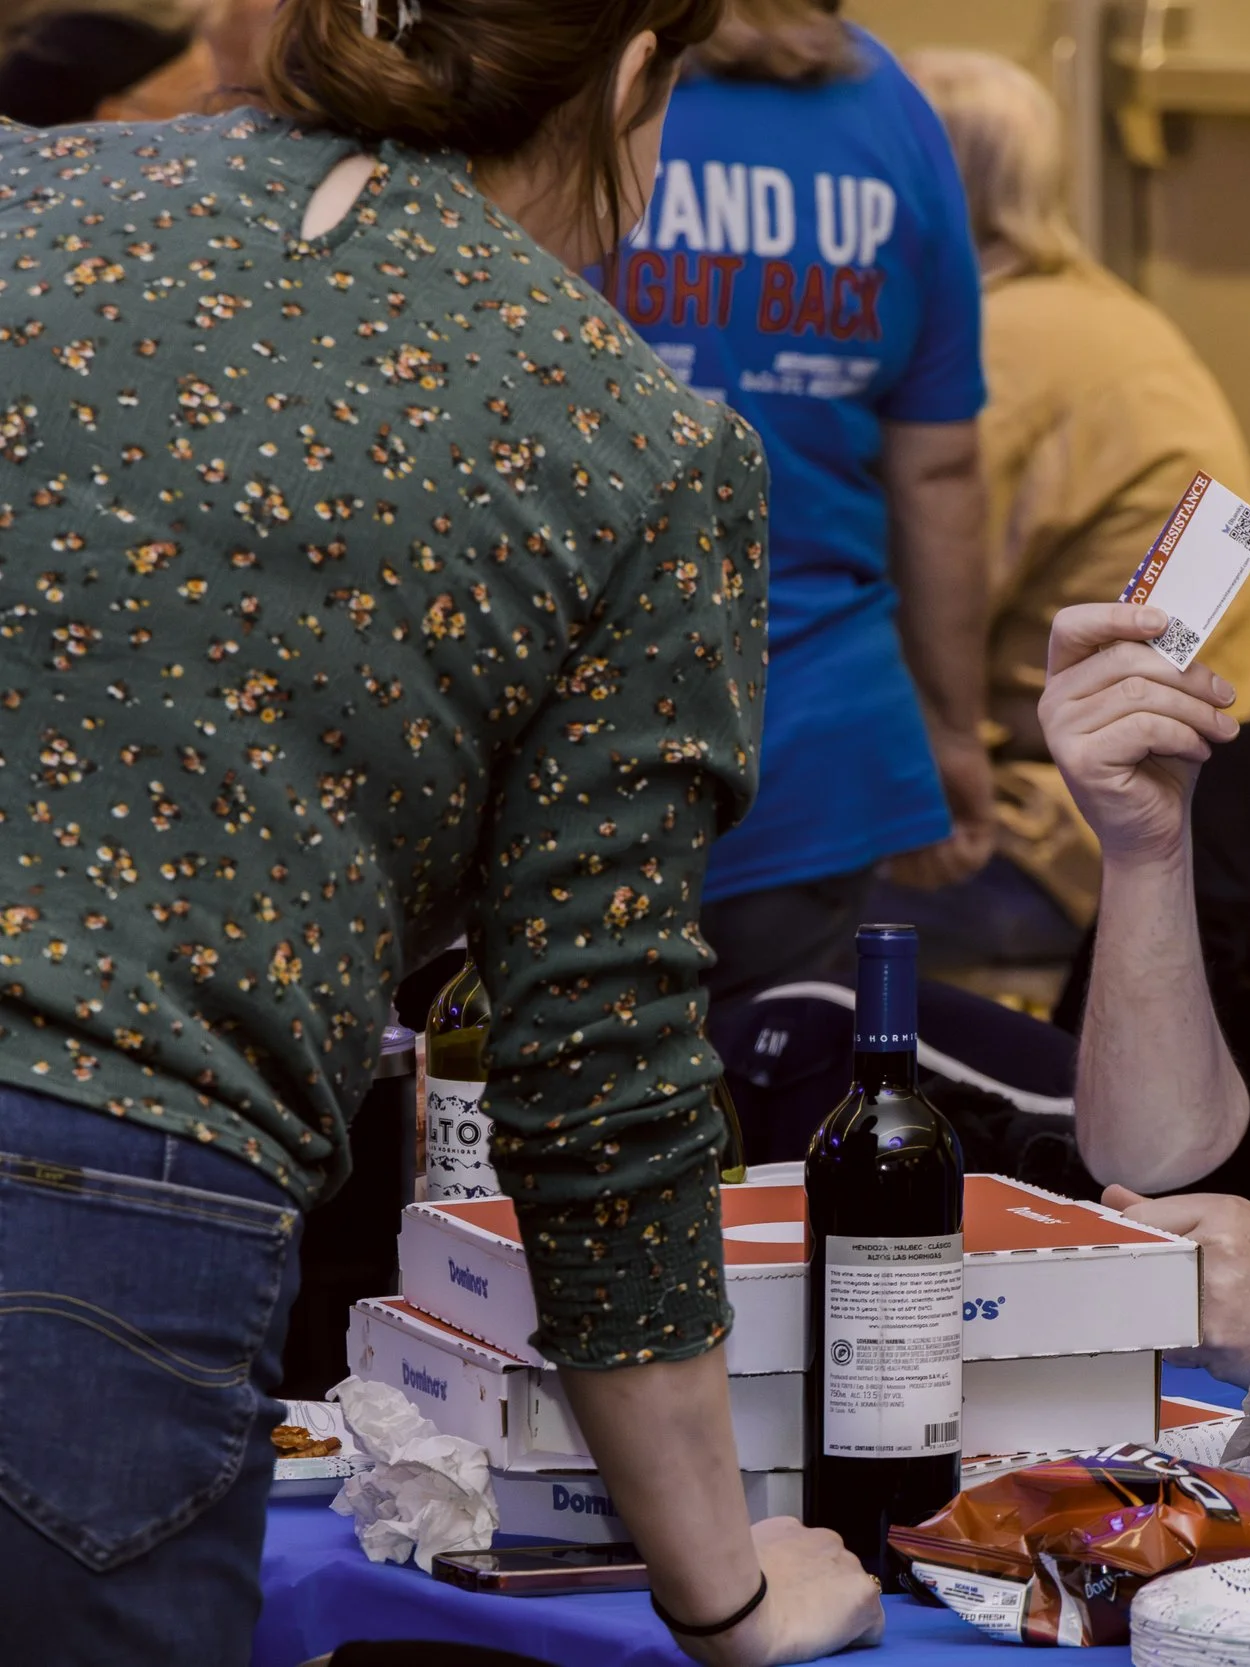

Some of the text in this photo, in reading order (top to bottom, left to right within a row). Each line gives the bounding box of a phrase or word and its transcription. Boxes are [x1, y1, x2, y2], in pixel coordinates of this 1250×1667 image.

[814, 172, 897, 267] UP
[757, 260, 888, 342] BACK
[1143, 559, 1164, 585] STL
[1158, 475, 1208, 556] RESISTANCE
[908, 1252, 942, 1260] HORMIGAS
[928, 1241, 952, 1250] CLÁSICO
[552, 1484, 619, 1517] Domi
